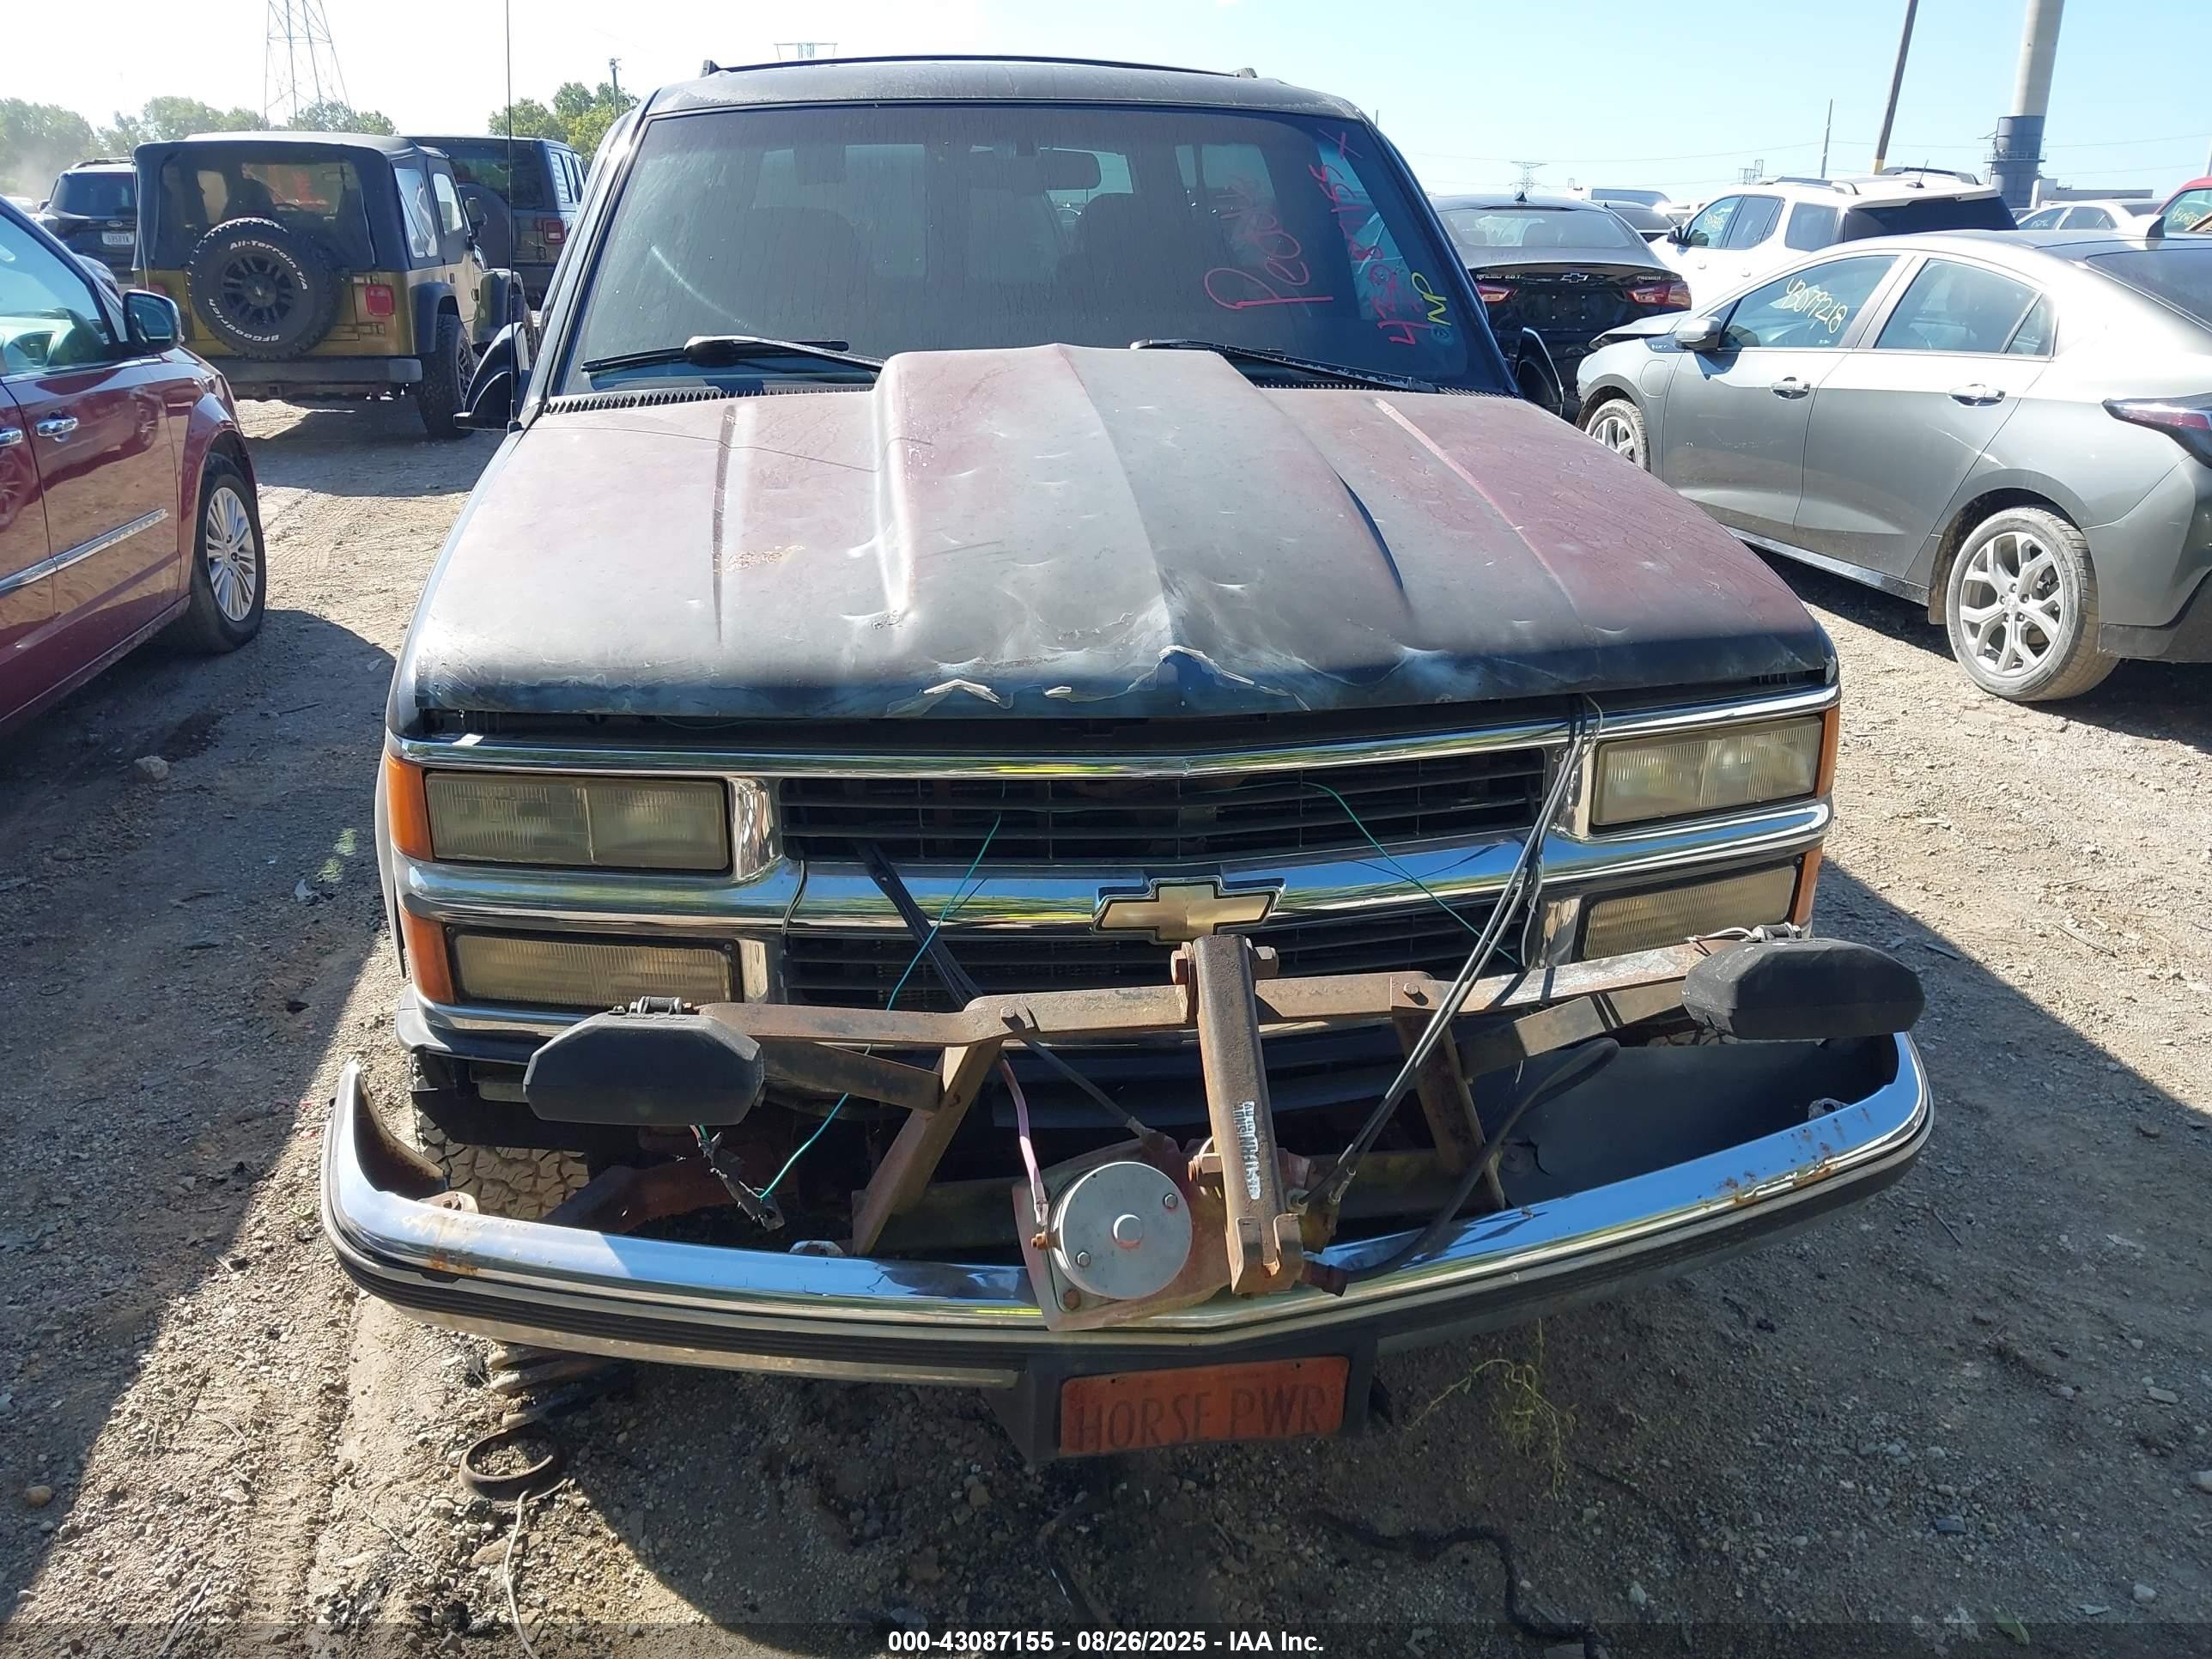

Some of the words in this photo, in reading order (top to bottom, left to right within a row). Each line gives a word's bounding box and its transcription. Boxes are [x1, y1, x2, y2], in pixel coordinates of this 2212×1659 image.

[229, 240, 297, 270] All-Terrain
[295, 270, 308, 290] T/A
[208, 298, 279, 342] BFGoodrich
[1076, 1391, 1212, 1453] HORSE
[1229, 1383, 1327, 1437] PWR
